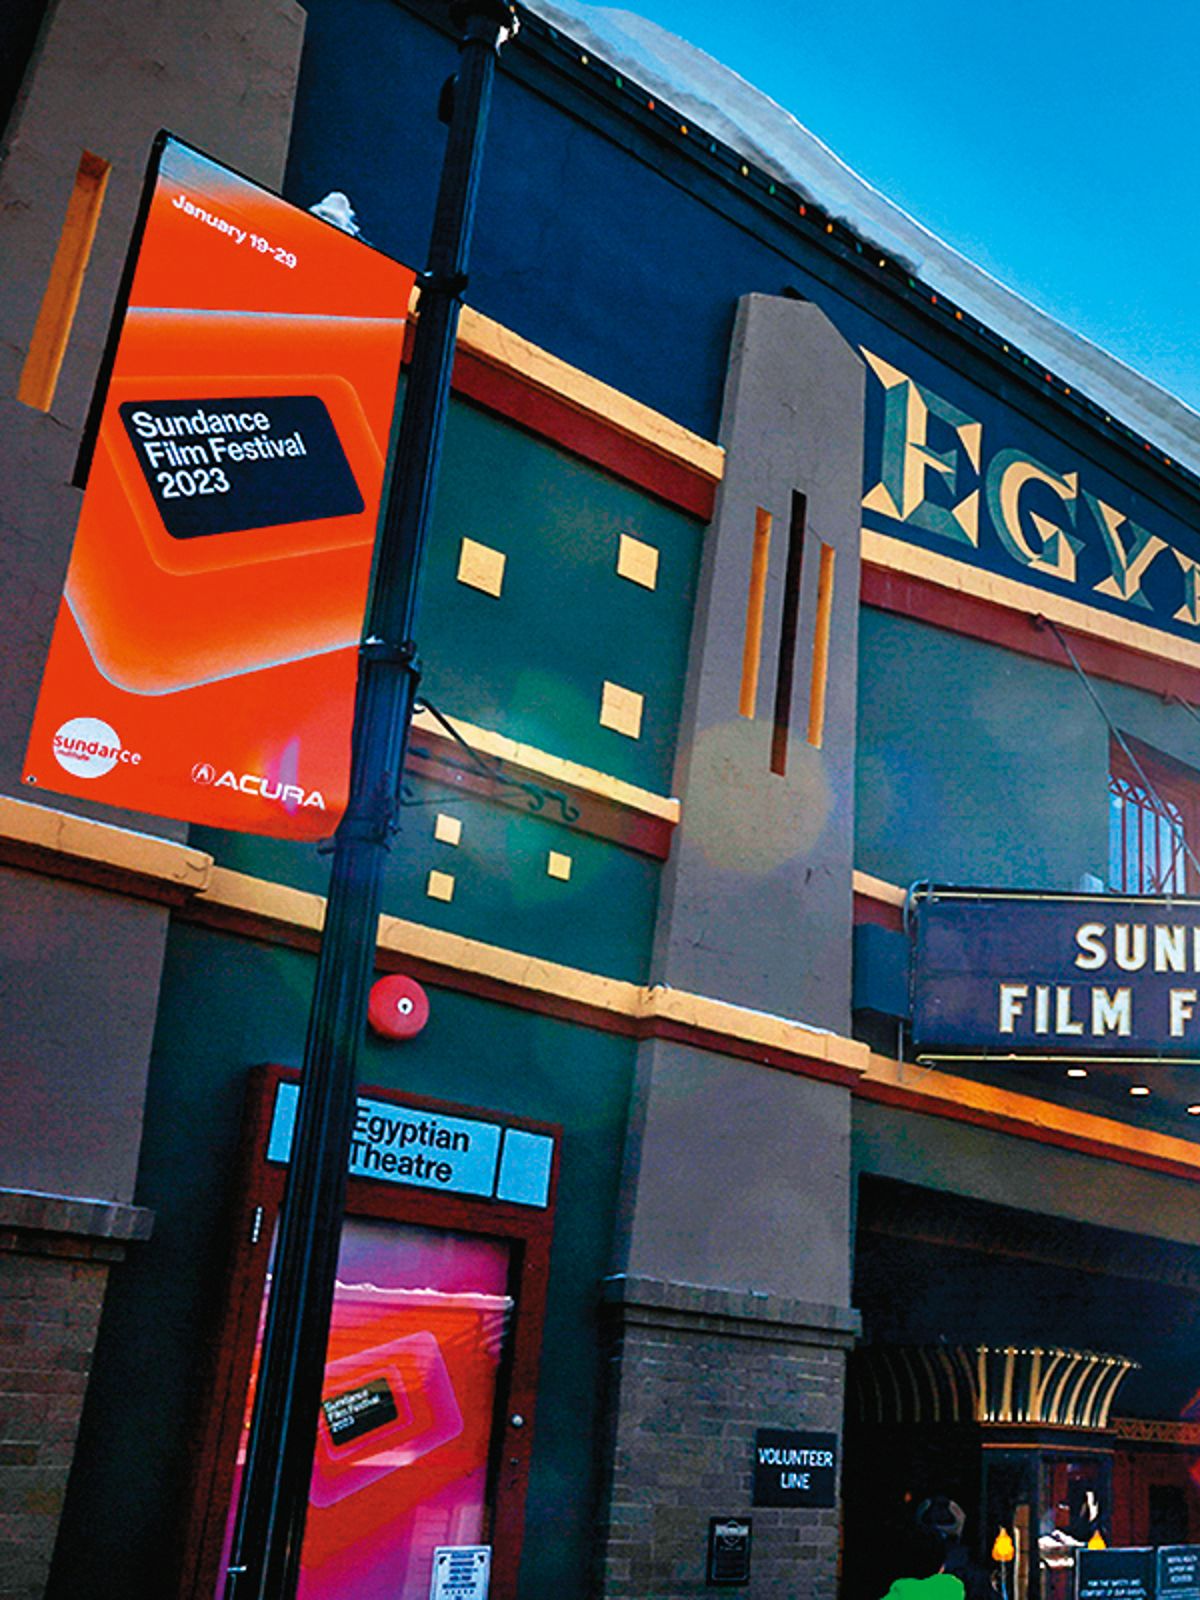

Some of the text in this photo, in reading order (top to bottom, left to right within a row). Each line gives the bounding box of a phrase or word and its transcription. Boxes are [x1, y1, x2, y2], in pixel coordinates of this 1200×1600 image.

[171, 195, 298, 269] January 19-29
[131, 409, 271, 438] Sundance
[143, 432, 307, 469] Film Festival
[156, 467, 230, 499] 2023
[53, 733, 142, 765] sundance
[214, 771, 326, 810] ACURA
[998, 983, 1132, 1037] FILM
[354, 1107, 470, 1152] Egyptian
[351, 1140, 453, 1183] Theatre
[758, 1447, 833, 1468] VOLUNTEER
[781, 1472, 811, 1490] LINE
